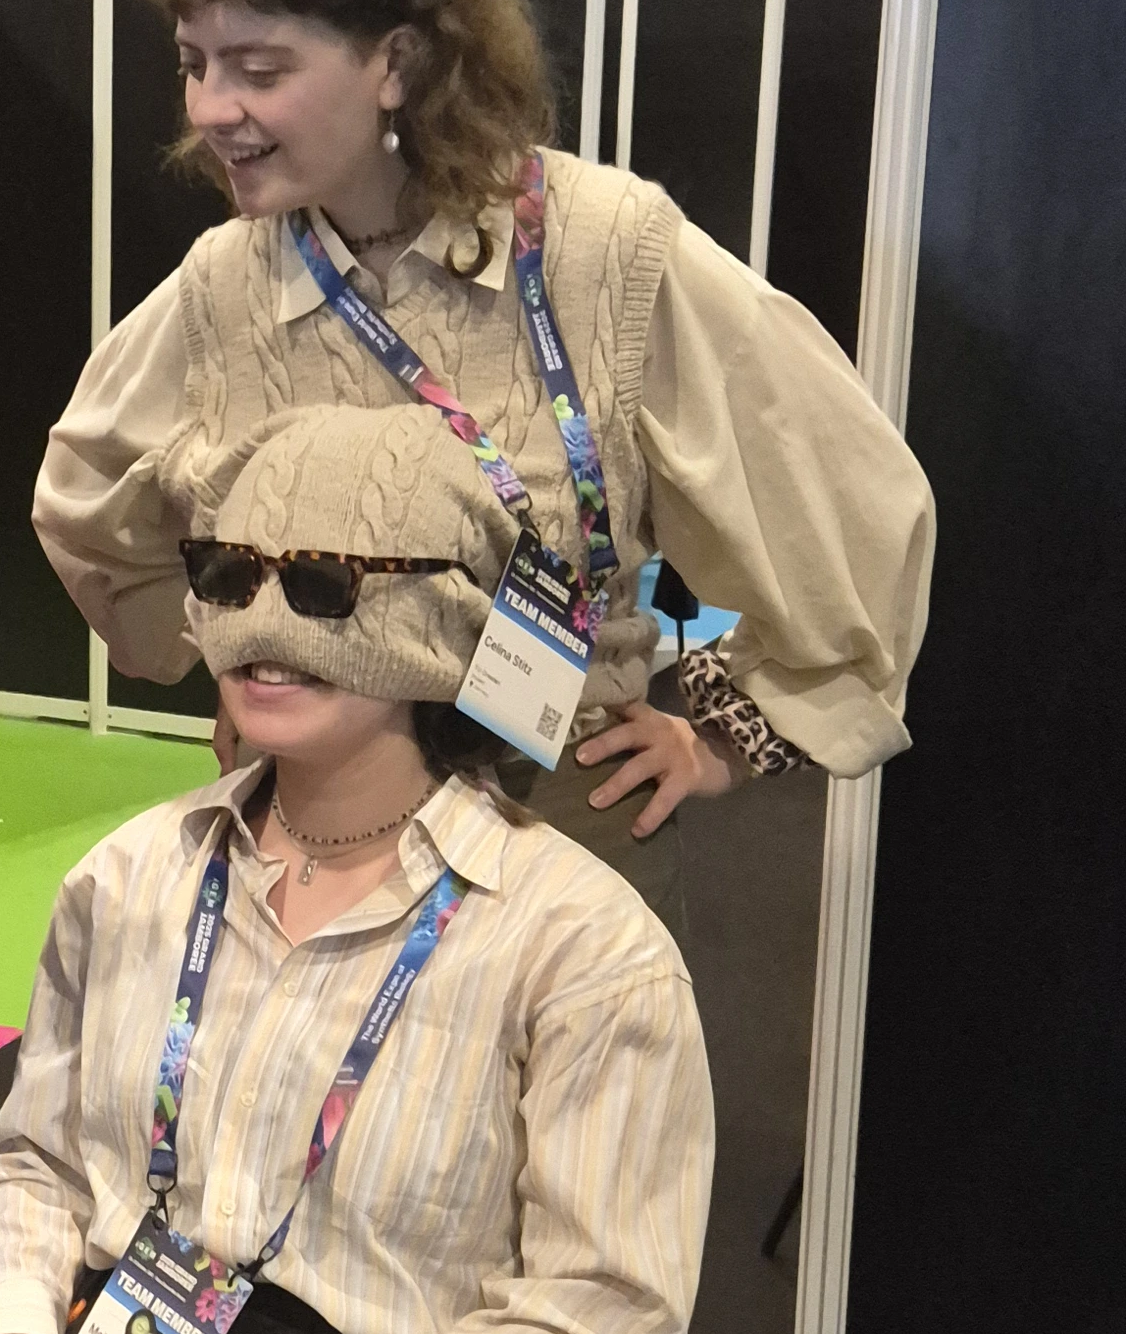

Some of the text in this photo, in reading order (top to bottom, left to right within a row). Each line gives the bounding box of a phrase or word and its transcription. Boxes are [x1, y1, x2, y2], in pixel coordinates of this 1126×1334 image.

[504, 586, 539, 622] TEAM
[538, 612, 589, 659] MEMBER
[484, 635, 512, 662] Celina
[117, 1270, 154, 1308] TEAM
